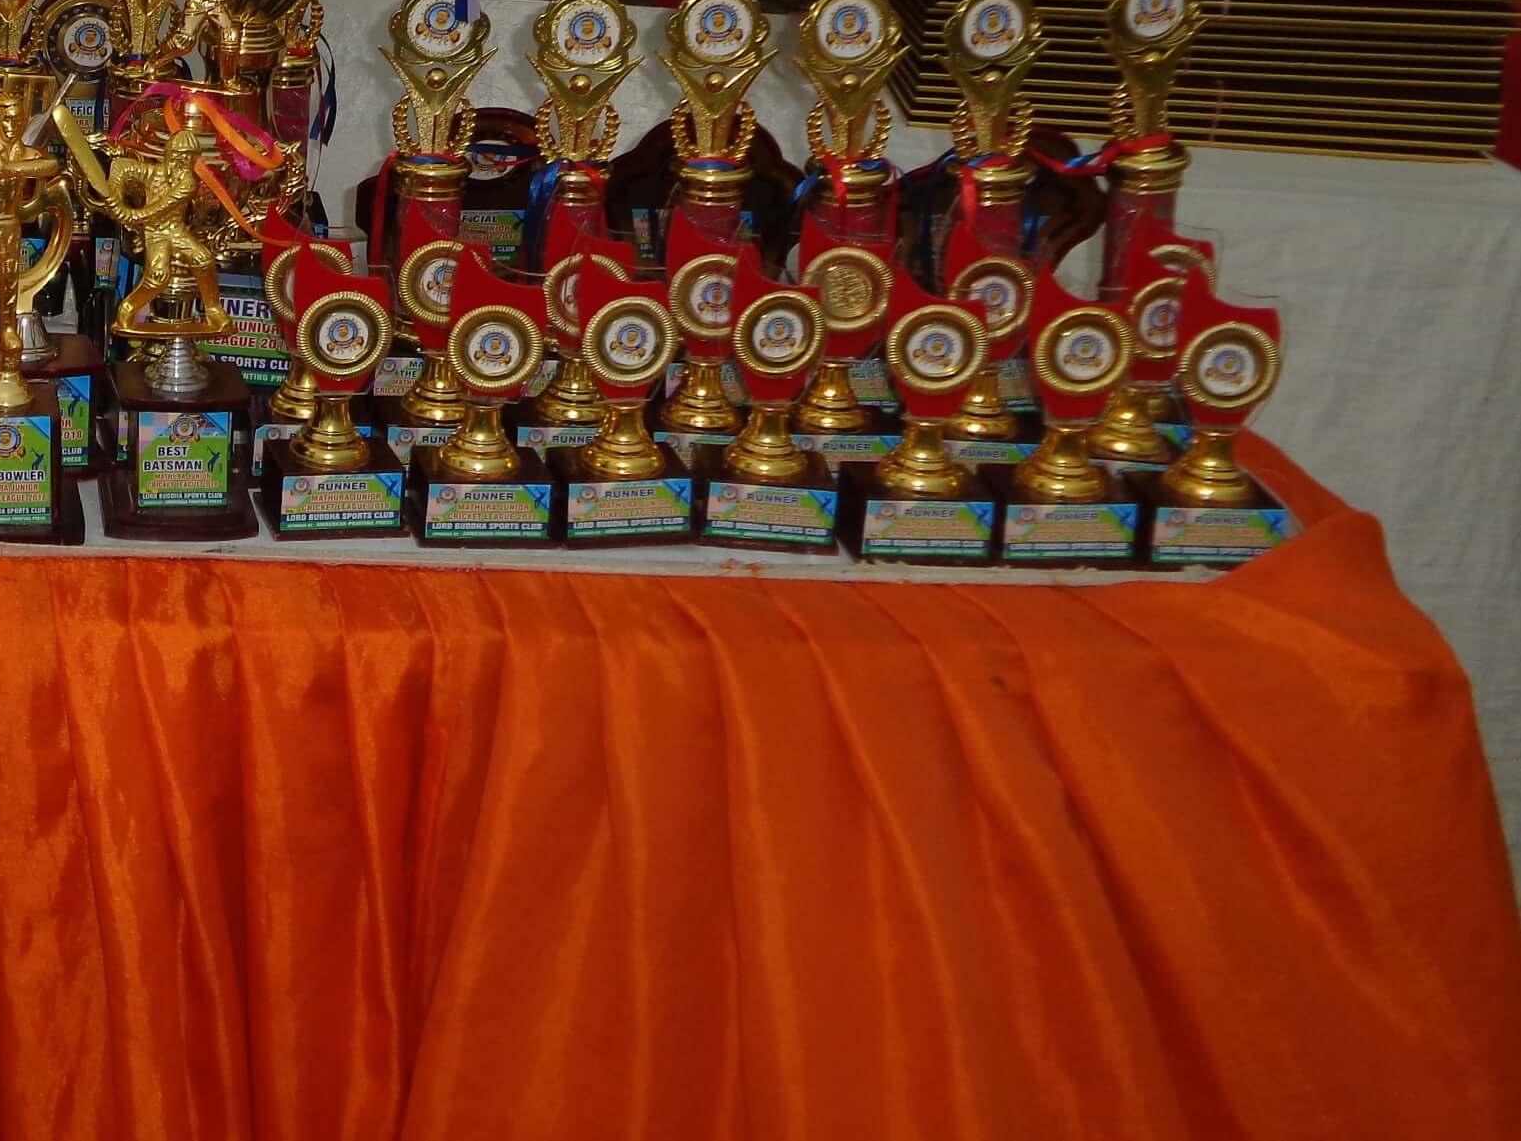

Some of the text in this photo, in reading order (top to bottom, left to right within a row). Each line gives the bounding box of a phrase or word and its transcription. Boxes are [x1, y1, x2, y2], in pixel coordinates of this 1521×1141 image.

[206, 335, 256, 349] LEAGUE
[270, 358, 291, 371] CLU
[551, 435, 593, 444] RUNNE
[158, 446, 188, 456] BEST
[822, 442, 872, 452] RUNNER
[144, 460, 202, 471] BATSMAN
[318, 482, 367, 491] RUNNER
[464, 492, 513, 500] RUNNER
[605, 489, 655, 498] RUNNER
[747, 492, 799, 503] RUNNER
